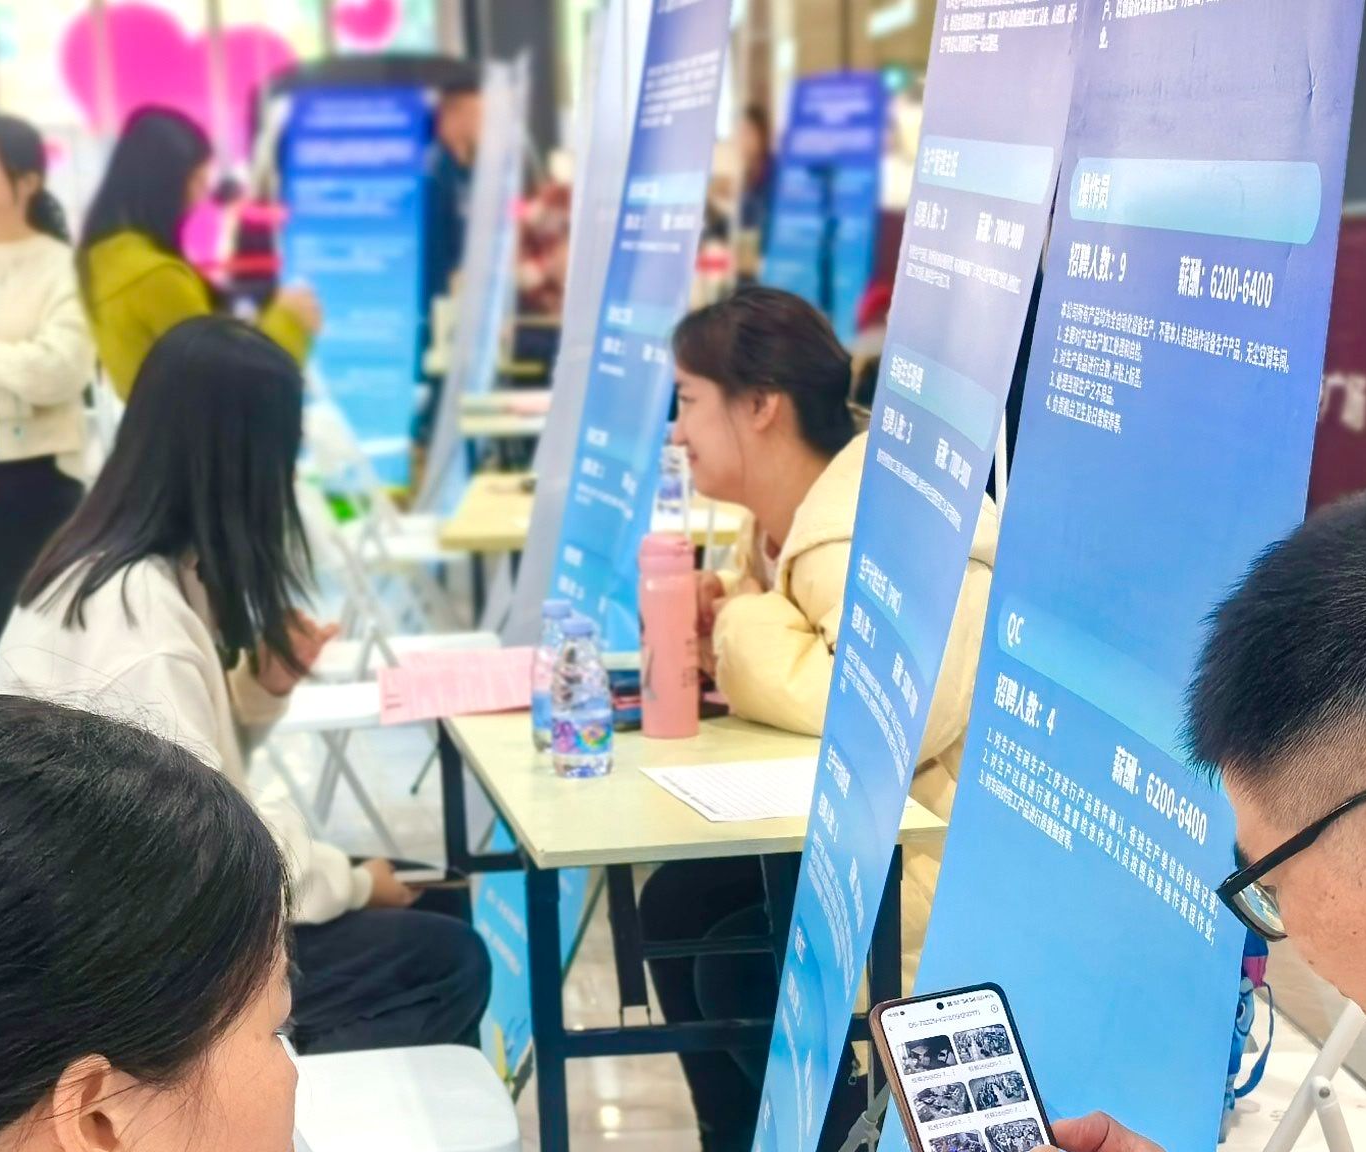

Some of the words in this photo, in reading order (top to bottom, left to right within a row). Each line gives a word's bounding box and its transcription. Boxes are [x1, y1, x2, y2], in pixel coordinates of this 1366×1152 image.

[1077, 173, 1110, 210] 操作员
[1177, 255, 1273, 308] 薪酬：6200-6400
[1007, 612, 1025, 648] QC
[1111, 745, 1208, 846] 薪酬：6200-6400
